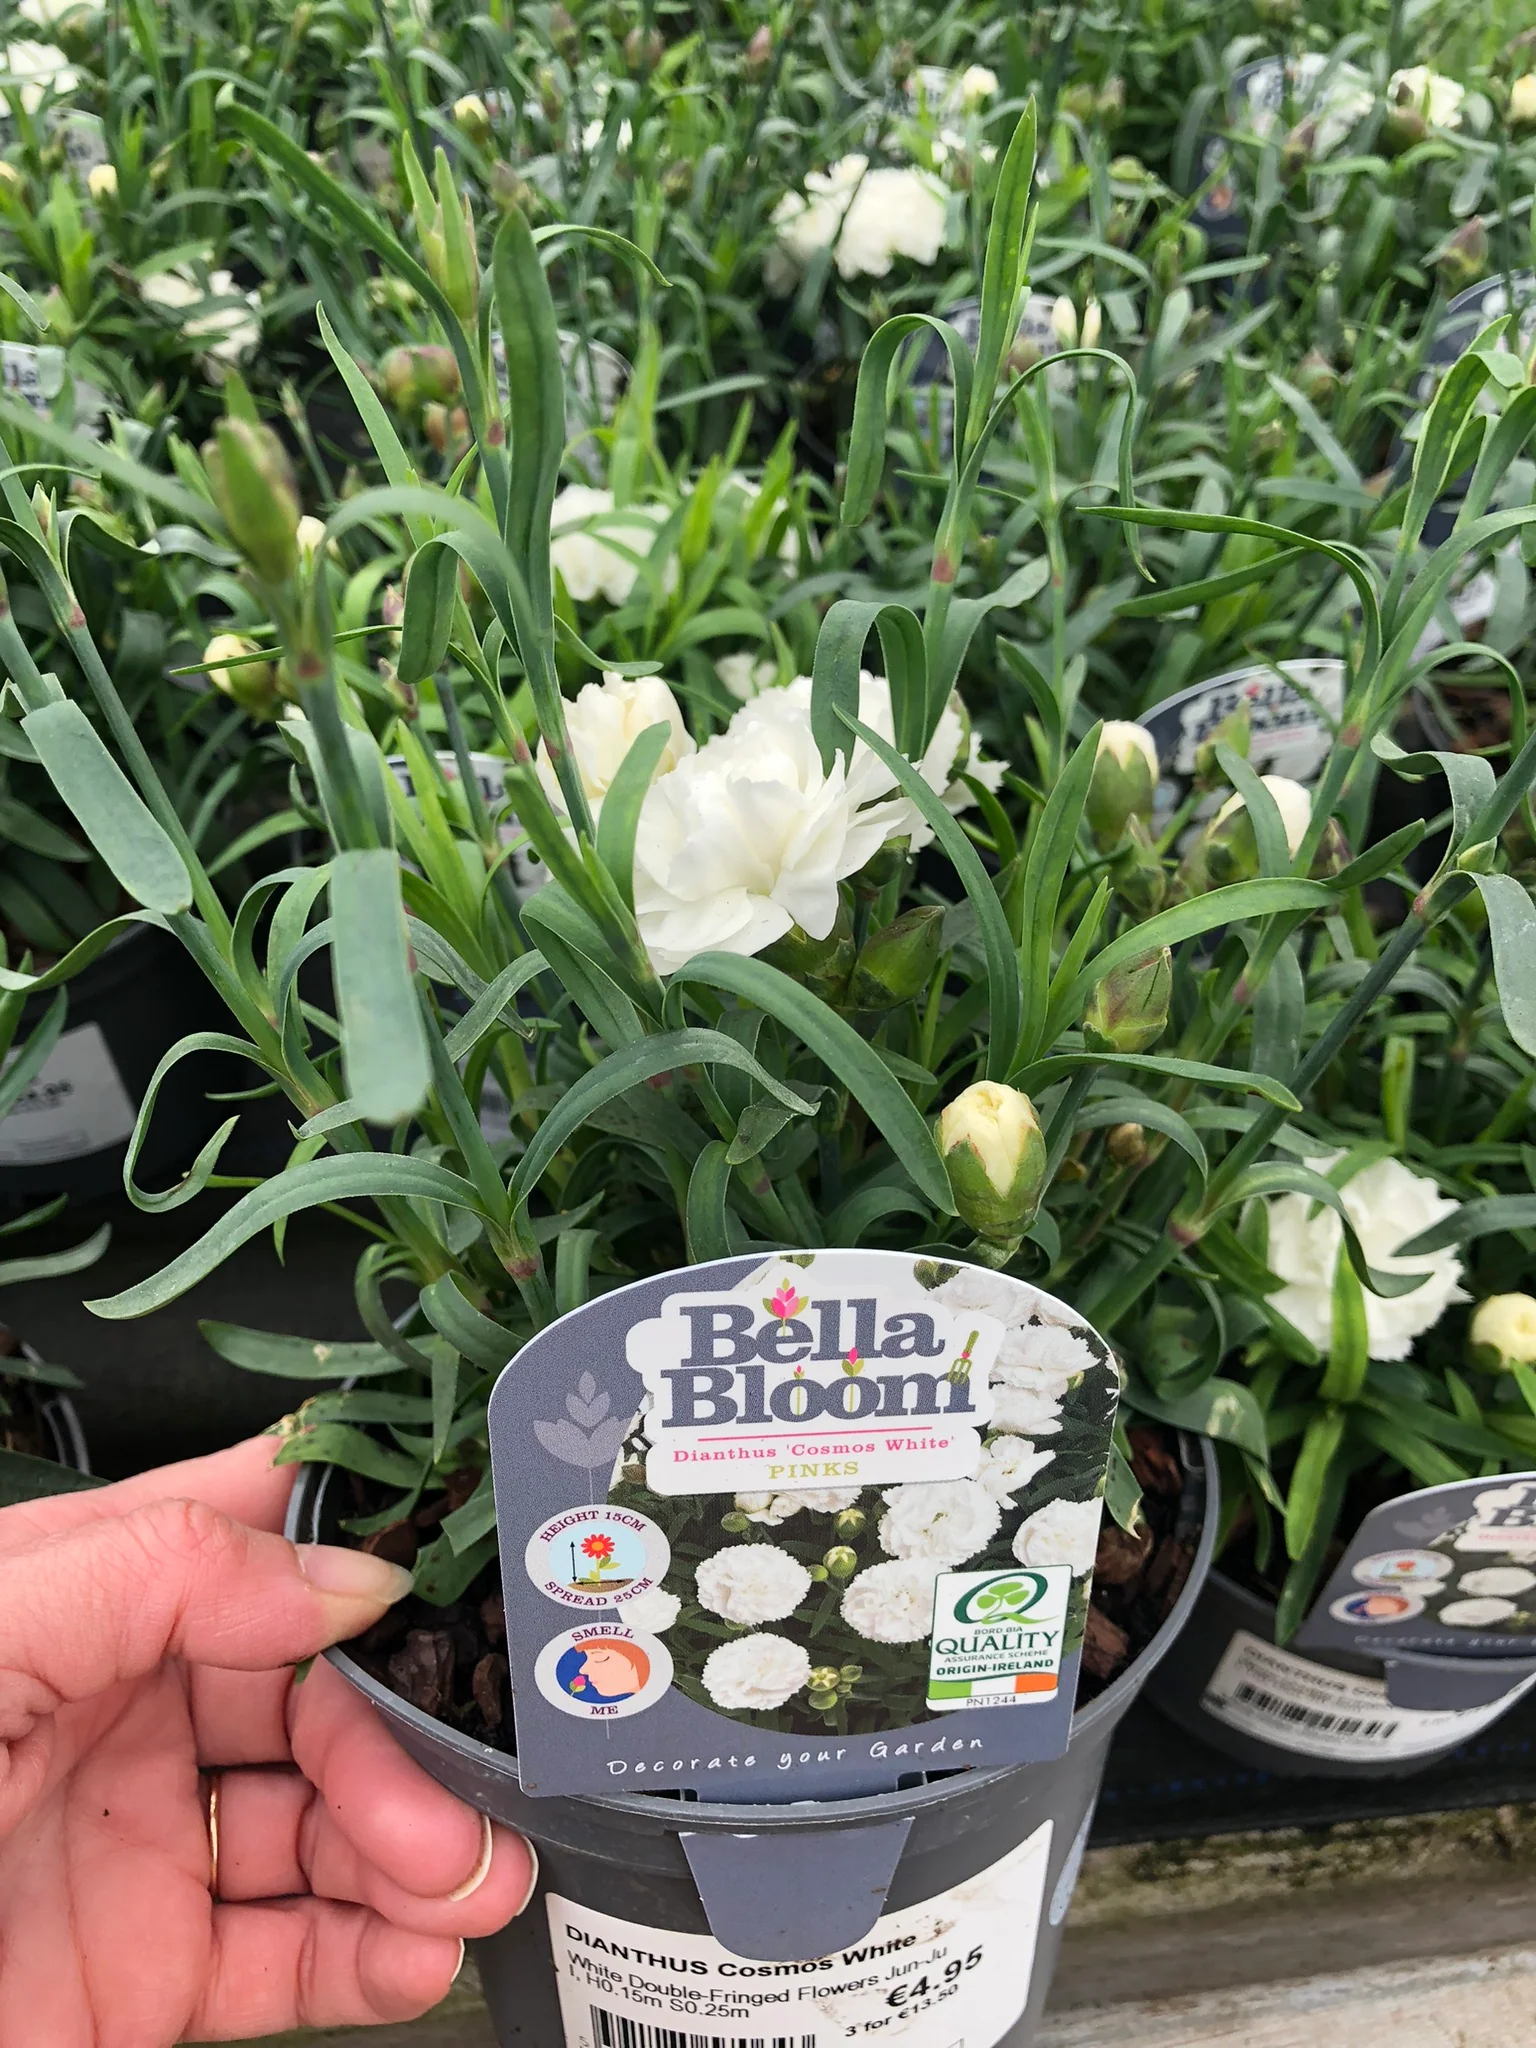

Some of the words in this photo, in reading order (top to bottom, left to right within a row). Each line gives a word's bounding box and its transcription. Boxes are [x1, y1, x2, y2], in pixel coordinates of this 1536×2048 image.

[680, 1298, 946, 1368] Bella
[661, 1364, 976, 1428] Bloom
[673, 1447, 777, 1463] Dianthus
[768, 1461, 860, 1479] PINKS
[540, 1510, 600, 1543] HEIGHT
[604, 1511, 648, 1533] 15CM
[544, 1581, 608, 1607] SPREAD
[613, 1577, 654, 1604] 25CM
[571, 1626, 635, 1642] SMELL
[935, 1630, 1060, 1655] QUALITY
[974, 1627, 1003, 1635] BORD
[936, 1659, 1055, 1676] ORIGIN-IRELAND
[943, 1653, 1005, 1663] ASSURANCE
[1008, 1649, 1049, 1659] SCHEME
[590, 1705, 619, 1715] ME
[966, 1695, 1017, 1707] PN1244
[606, 1755, 757, 1775] Decorate
[776, 1748, 848, 1770] your
[869, 1736, 984, 1759] Garden
[565, 1924, 709, 1976] DIANTHUS
[717, 1959, 834, 1978] Cosmos
[841, 1935, 917, 1967] White
[567, 1949, 623, 1984] White
[628, 1973, 790, 2007] Double-Fringed
[797, 1972, 880, 2001] Flowers
[884, 1946, 949, 1981] Jun-Ju
[884, 1943, 984, 2009] €4.95
[586, 1971, 663, 2009] H0.15m
[669, 1999, 750, 2019] S0.25m
[844, 2024, 858, 2037] 3
[863, 2016, 894, 2033] for
[896, 1983, 959, 2020] €13.50
